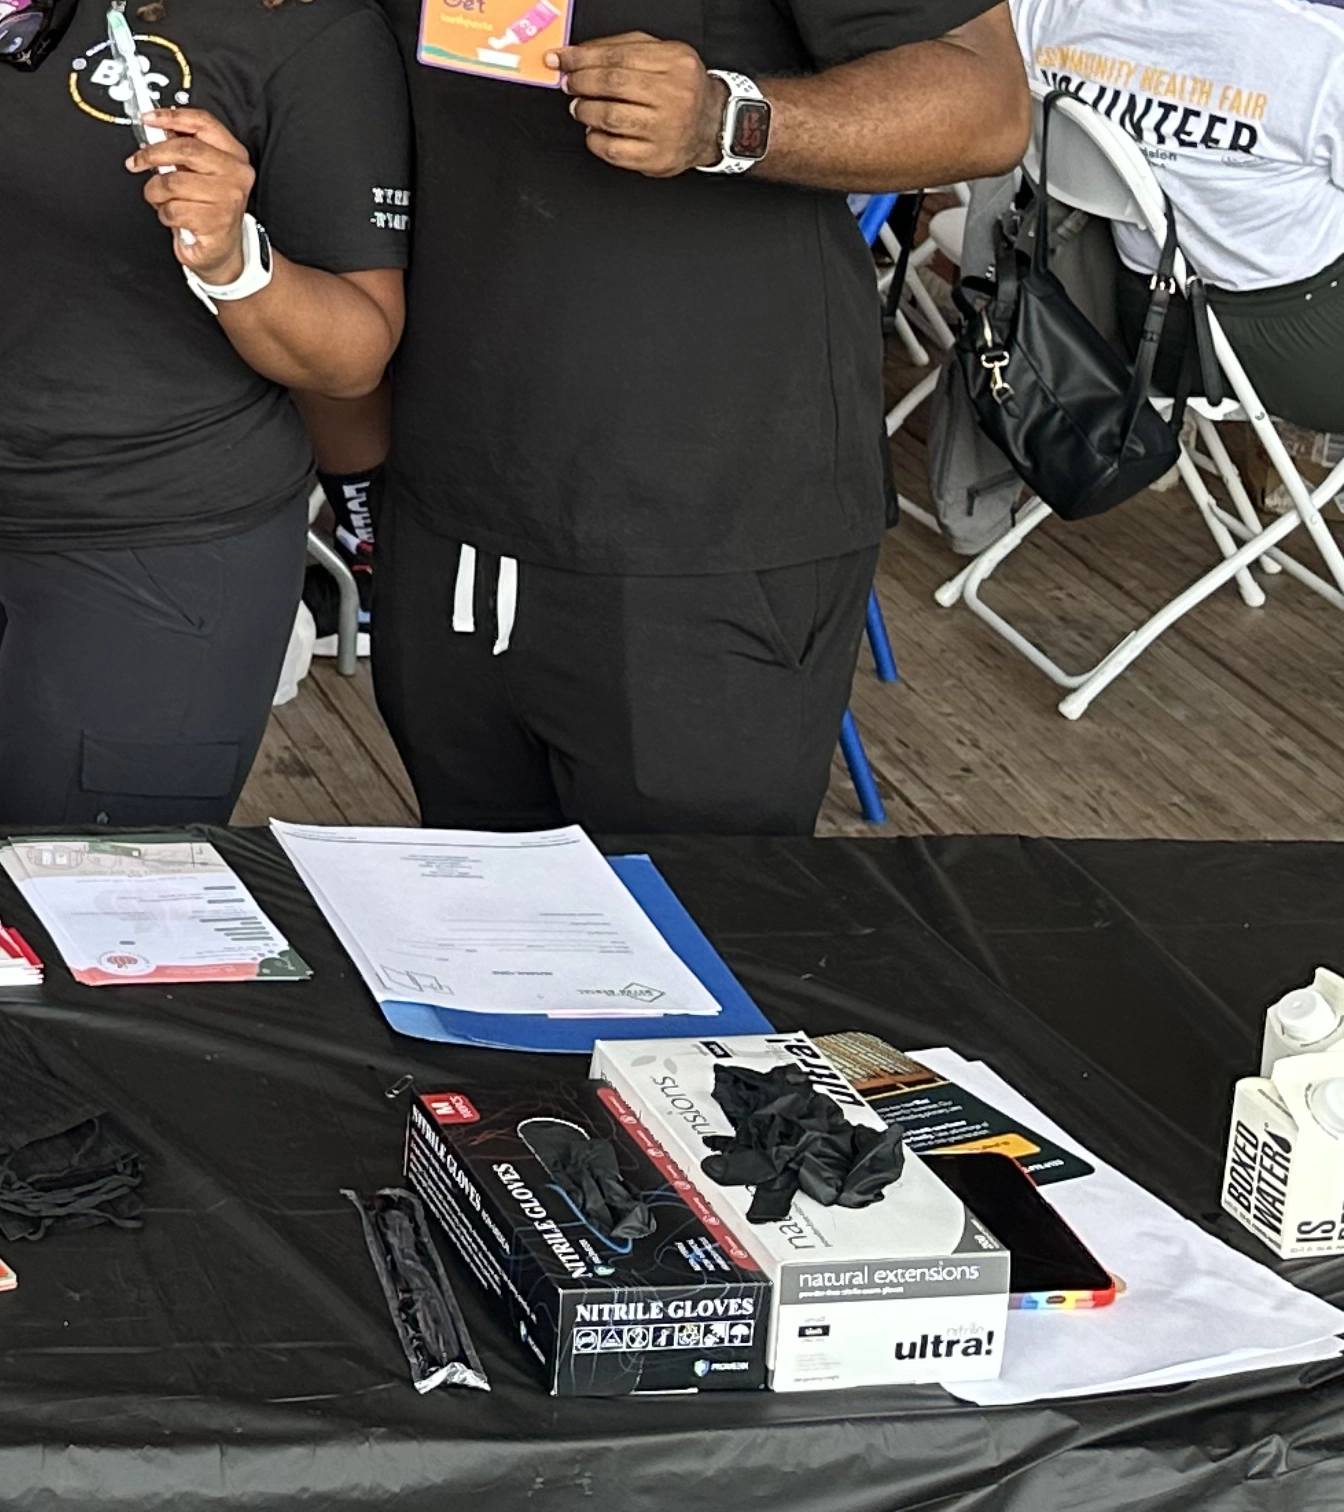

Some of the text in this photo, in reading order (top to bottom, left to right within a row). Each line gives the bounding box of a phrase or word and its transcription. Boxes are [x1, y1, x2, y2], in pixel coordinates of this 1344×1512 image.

[1139, 65, 1215, 108] HEALTH
[1217, 84, 1269, 122] FAIR
[649, 1074, 718, 1137] nsions
[413, 1103, 482, 1214] NITRILE GLOVES
[1227, 1119, 1260, 1215] BOXED
[1252, 1140, 1292, 1237] WATER
[492, 1162, 594, 1280] NITRILE GLOVES
[1296, 1219, 1337, 1243] IS
[798, 1261, 981, 1289] natural extensions
[574, 1297, 755, 1323] NITRILE GLOVES
[893, 1330, 995, 1361] ultra!
